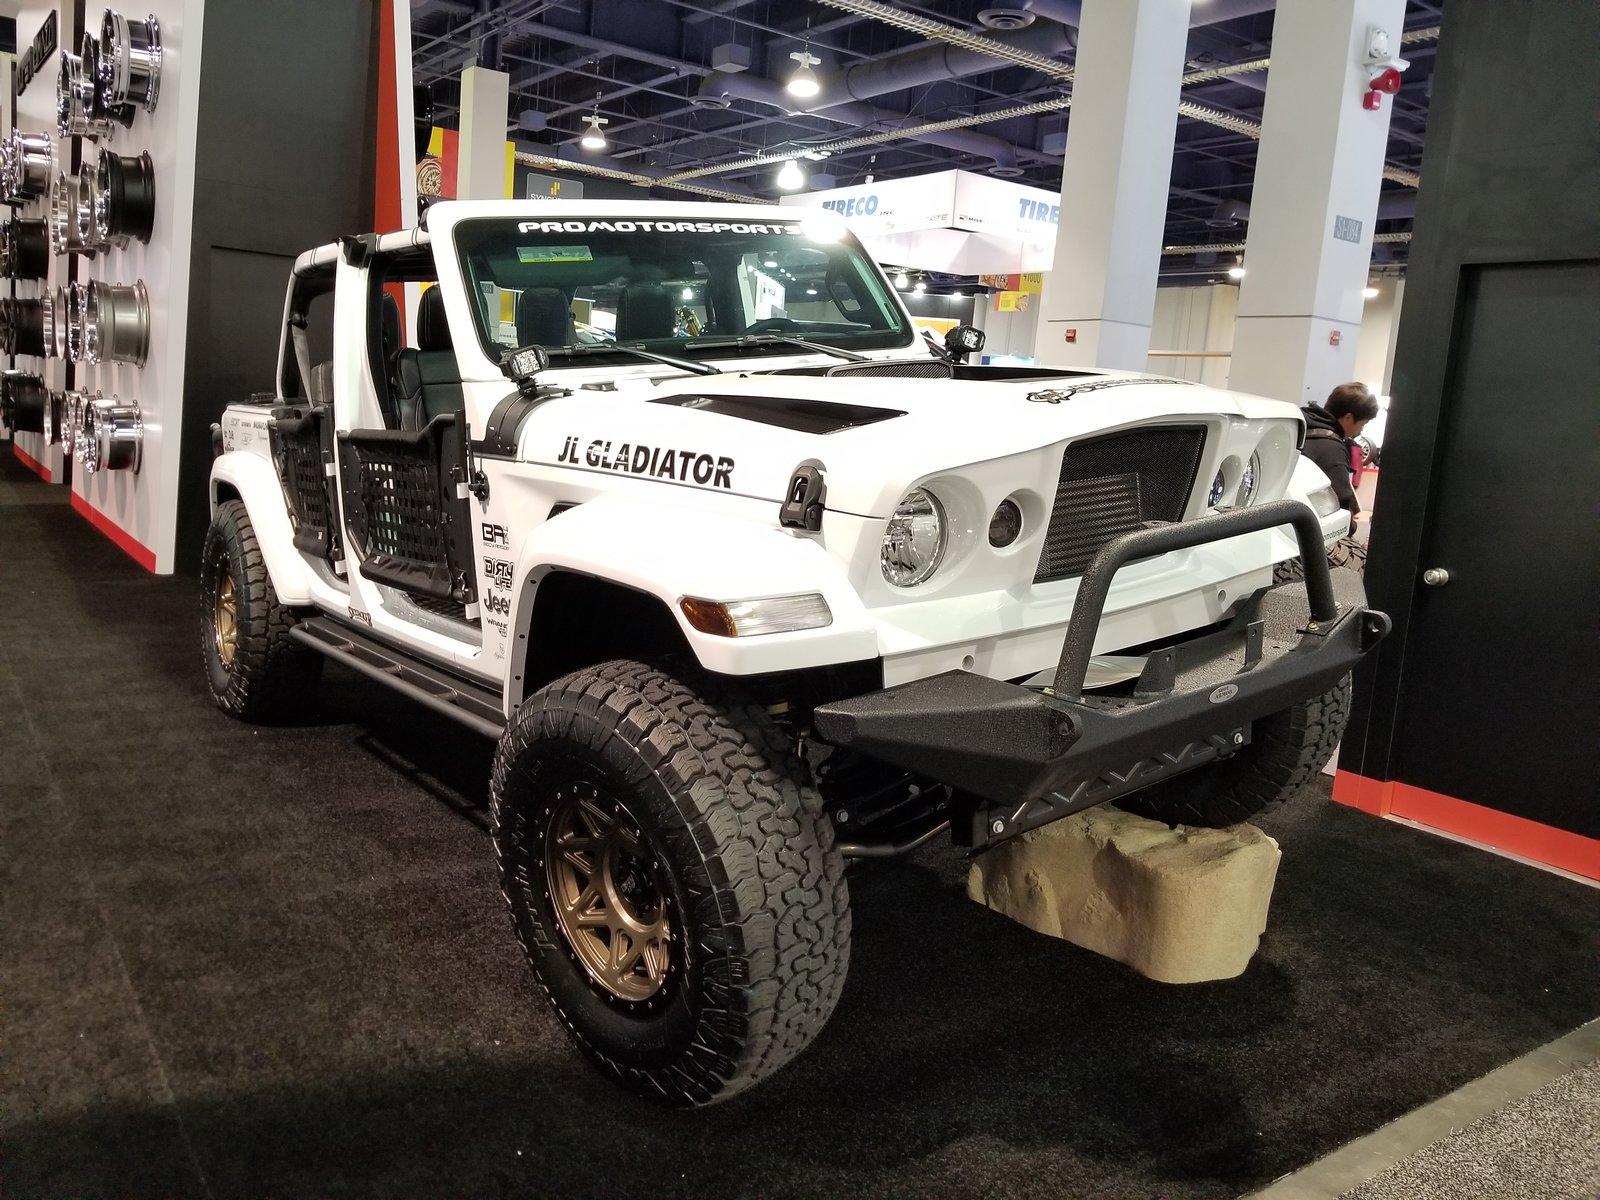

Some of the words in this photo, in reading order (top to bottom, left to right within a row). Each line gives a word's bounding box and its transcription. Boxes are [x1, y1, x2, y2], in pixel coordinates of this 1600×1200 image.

[518, 221, 803, 236] PROMOTORSPORTS
[558, 436, 579, 464] JL
[586, 439, 735, 489] GLADIATOR
[484, 558, 514, 579] DIRTY
